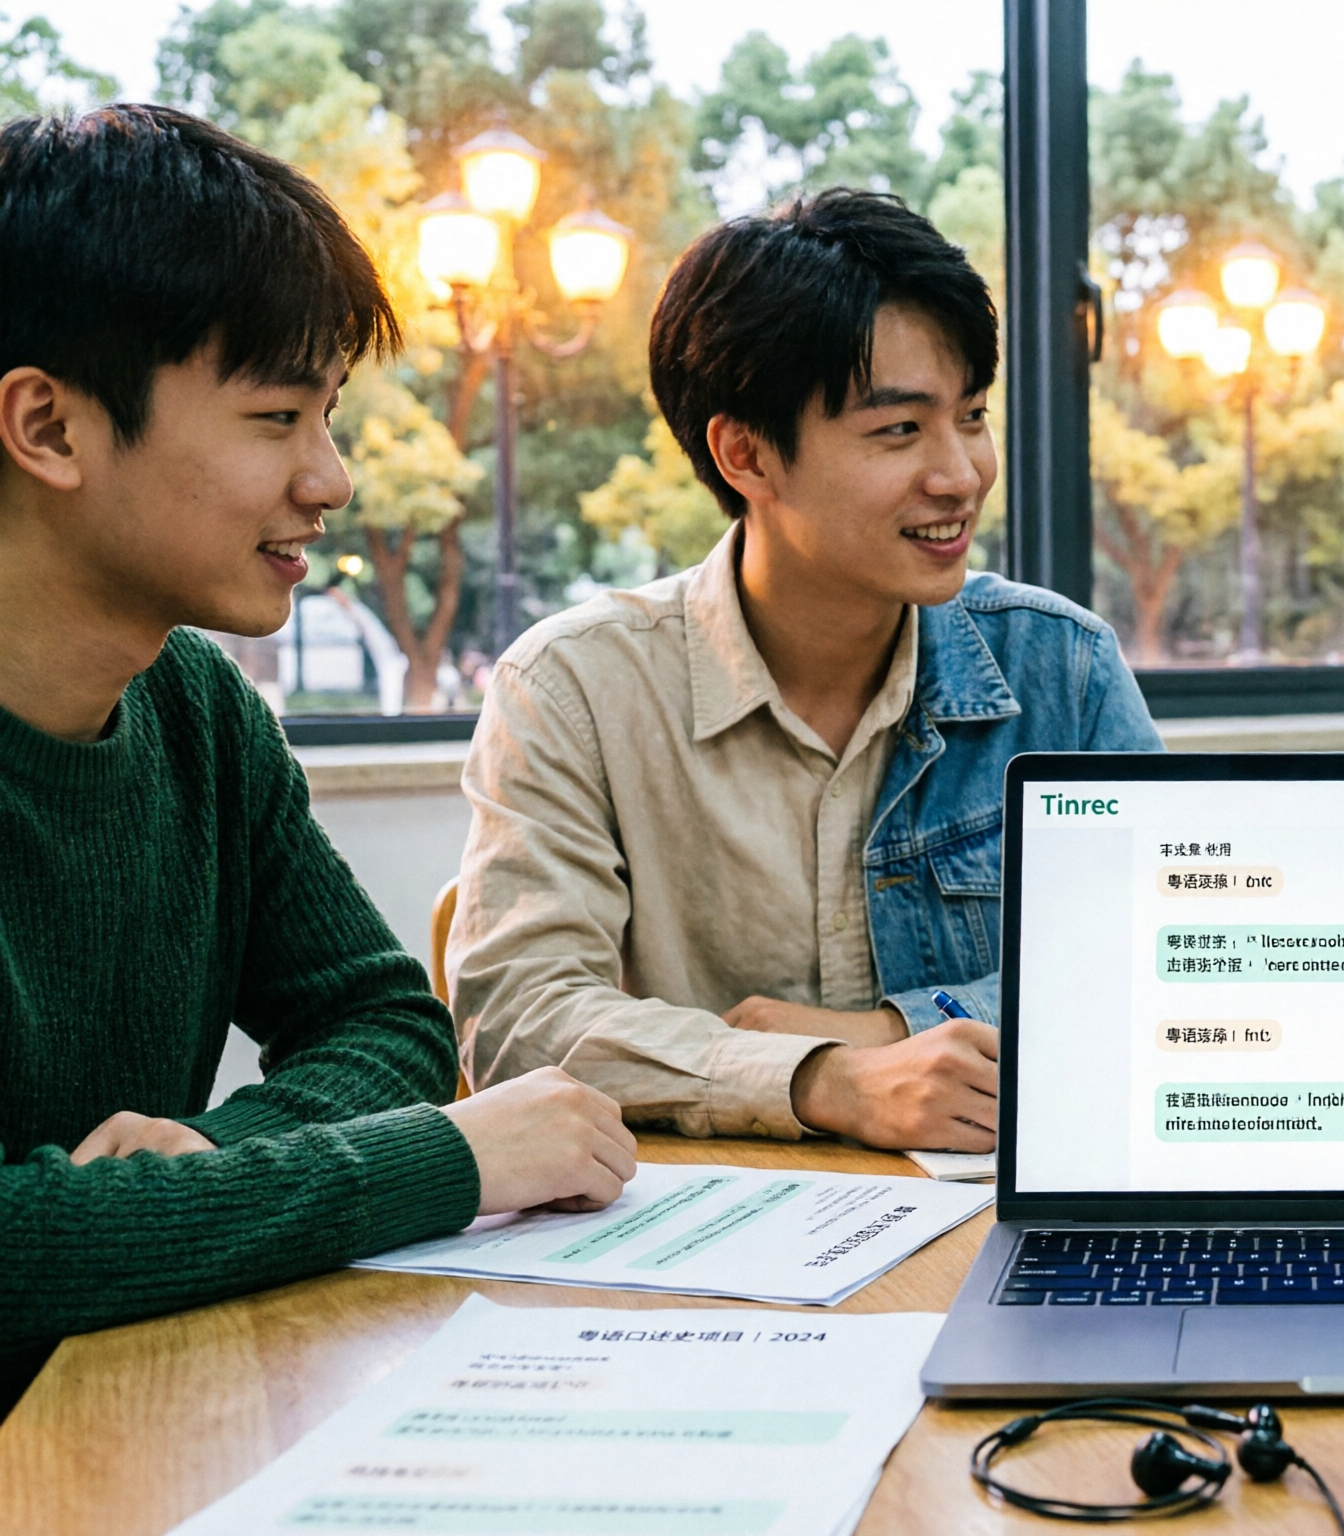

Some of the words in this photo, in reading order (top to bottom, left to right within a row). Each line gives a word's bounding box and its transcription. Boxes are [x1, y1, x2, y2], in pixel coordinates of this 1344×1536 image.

[1040, 793, 1119, 815] Tinrec
[578, 1329, 744, 1343] 粤语口述史项目
[770, 1331, 827, 1342] 2024
